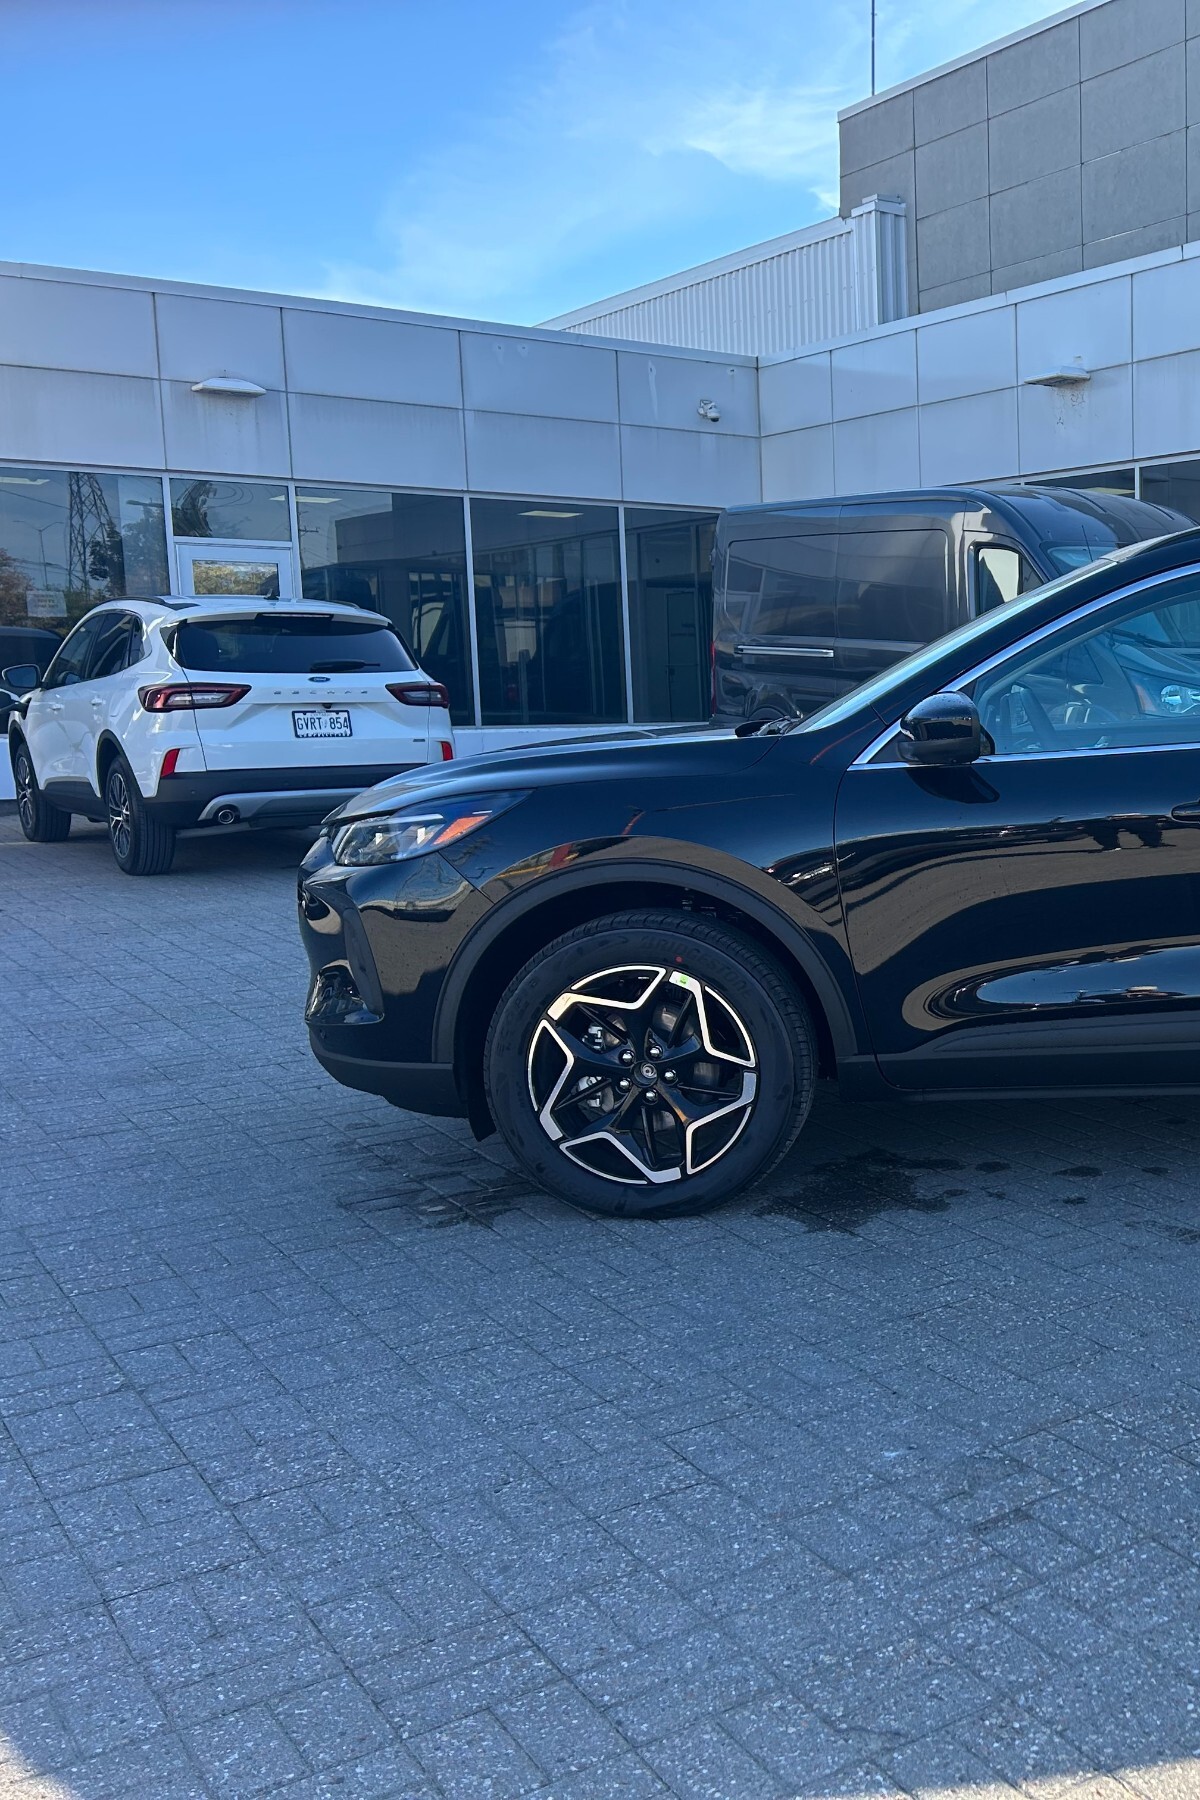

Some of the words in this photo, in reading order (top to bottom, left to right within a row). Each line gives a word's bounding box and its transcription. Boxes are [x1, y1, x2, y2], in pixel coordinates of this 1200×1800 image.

[297, 717, 322, 730] GVRT
[329, 716, 349, 730] 854
[640, 935, 751, 999] BRIDGESTONE
